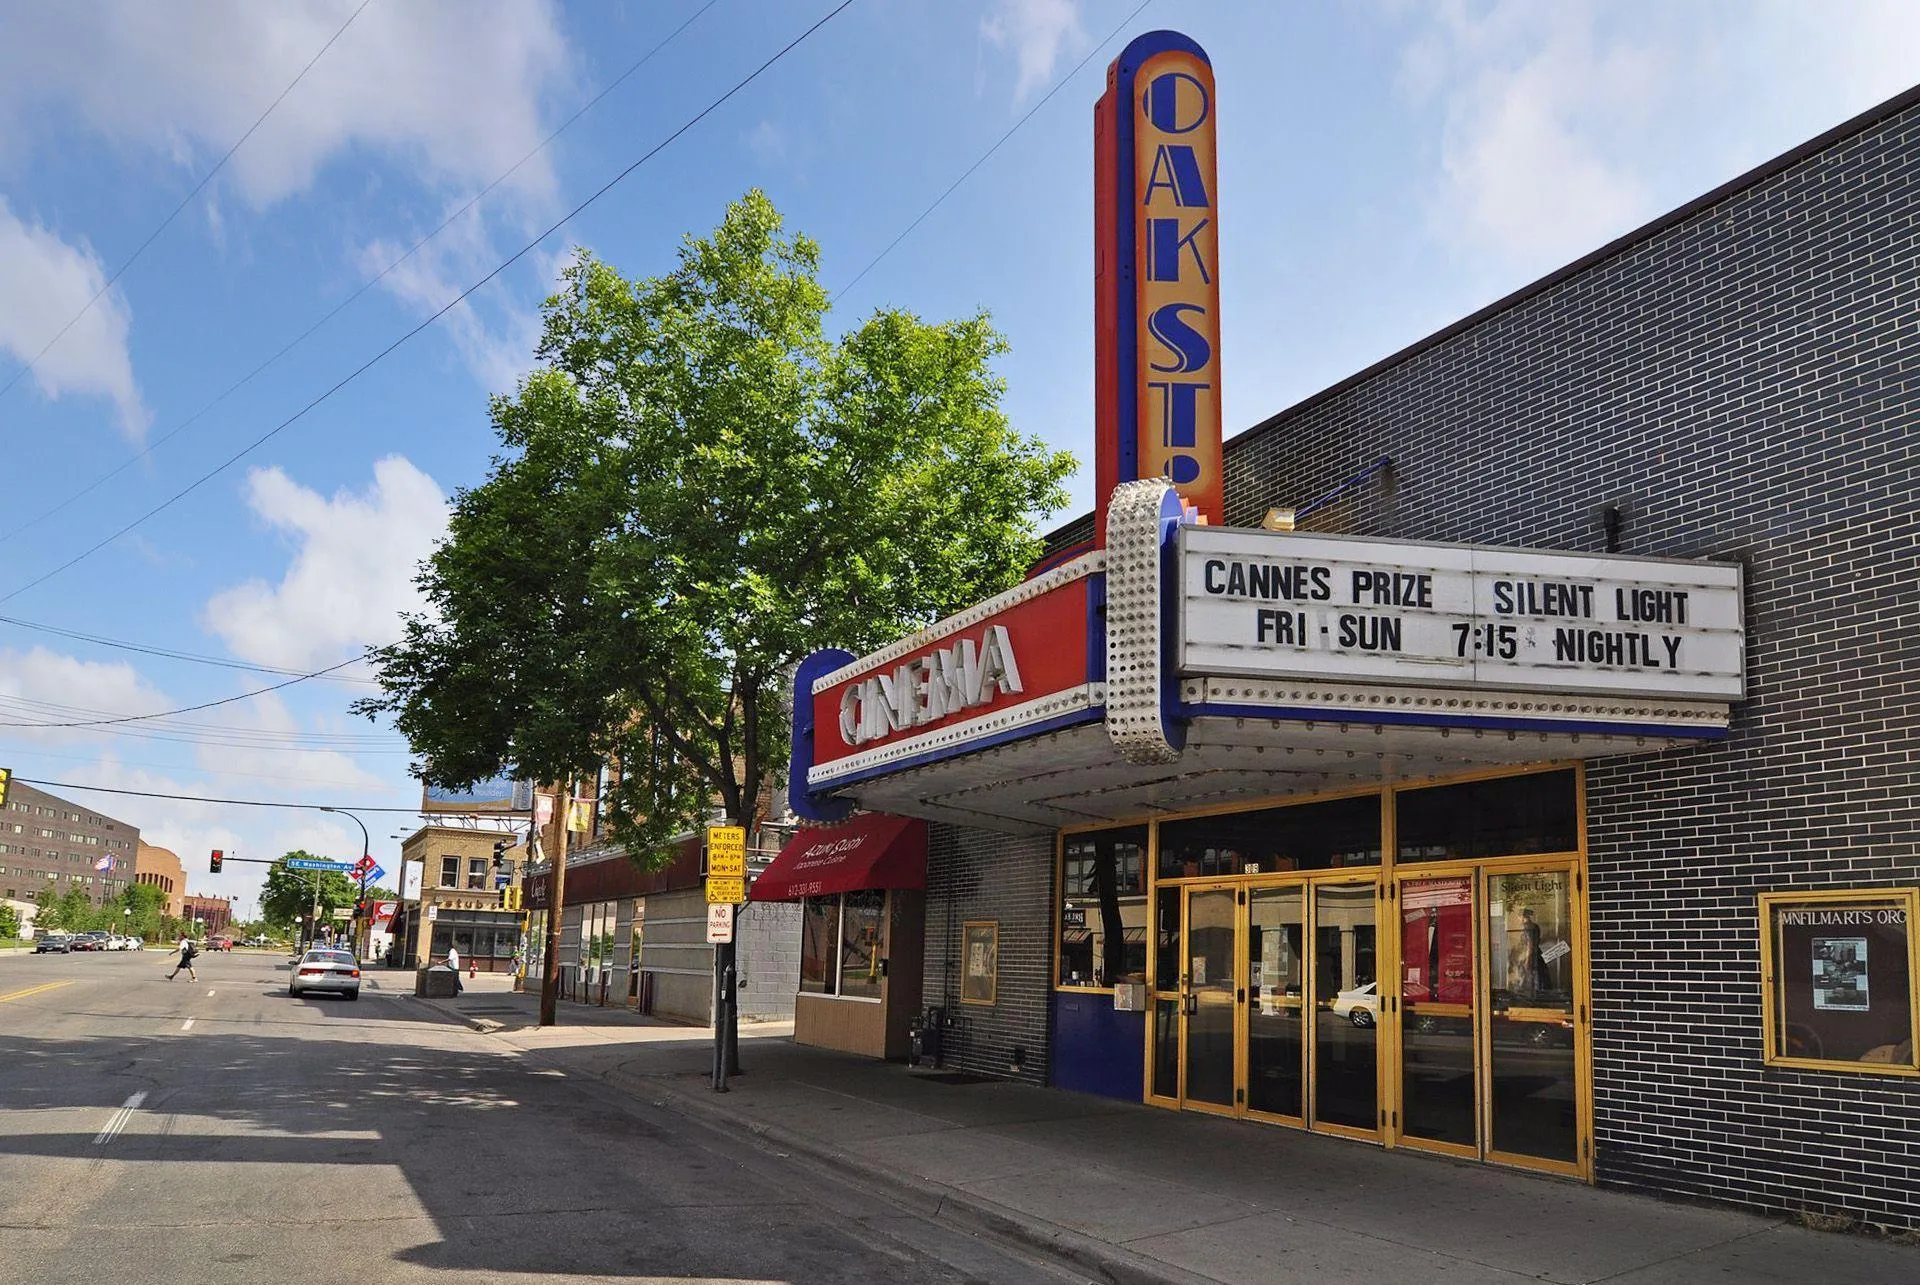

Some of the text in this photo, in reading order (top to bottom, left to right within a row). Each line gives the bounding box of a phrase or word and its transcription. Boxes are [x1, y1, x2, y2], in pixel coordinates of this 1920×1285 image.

[1204, 559, 1688, 625] CANNES PRIZE SILENT LIGHT
[1257, 608, 1306, 647] FRI
[1338, 613, 1401, 652] SUN
[1452, 622, 1517, 660] 7:15
[1556, 627, 1682, 669] NIGHTLY
[839, 624, 1024, 746] CINEMA
[713, 831, 740, 841] METERS
[710, 842, 744, 852] ENFORCED
[303, 861, 341, 871] Washington
[1501, 879, 1563, 893] Silent Light
[714, 908, 727, 919] NO
[709, 920, 731, 929] PARKING
